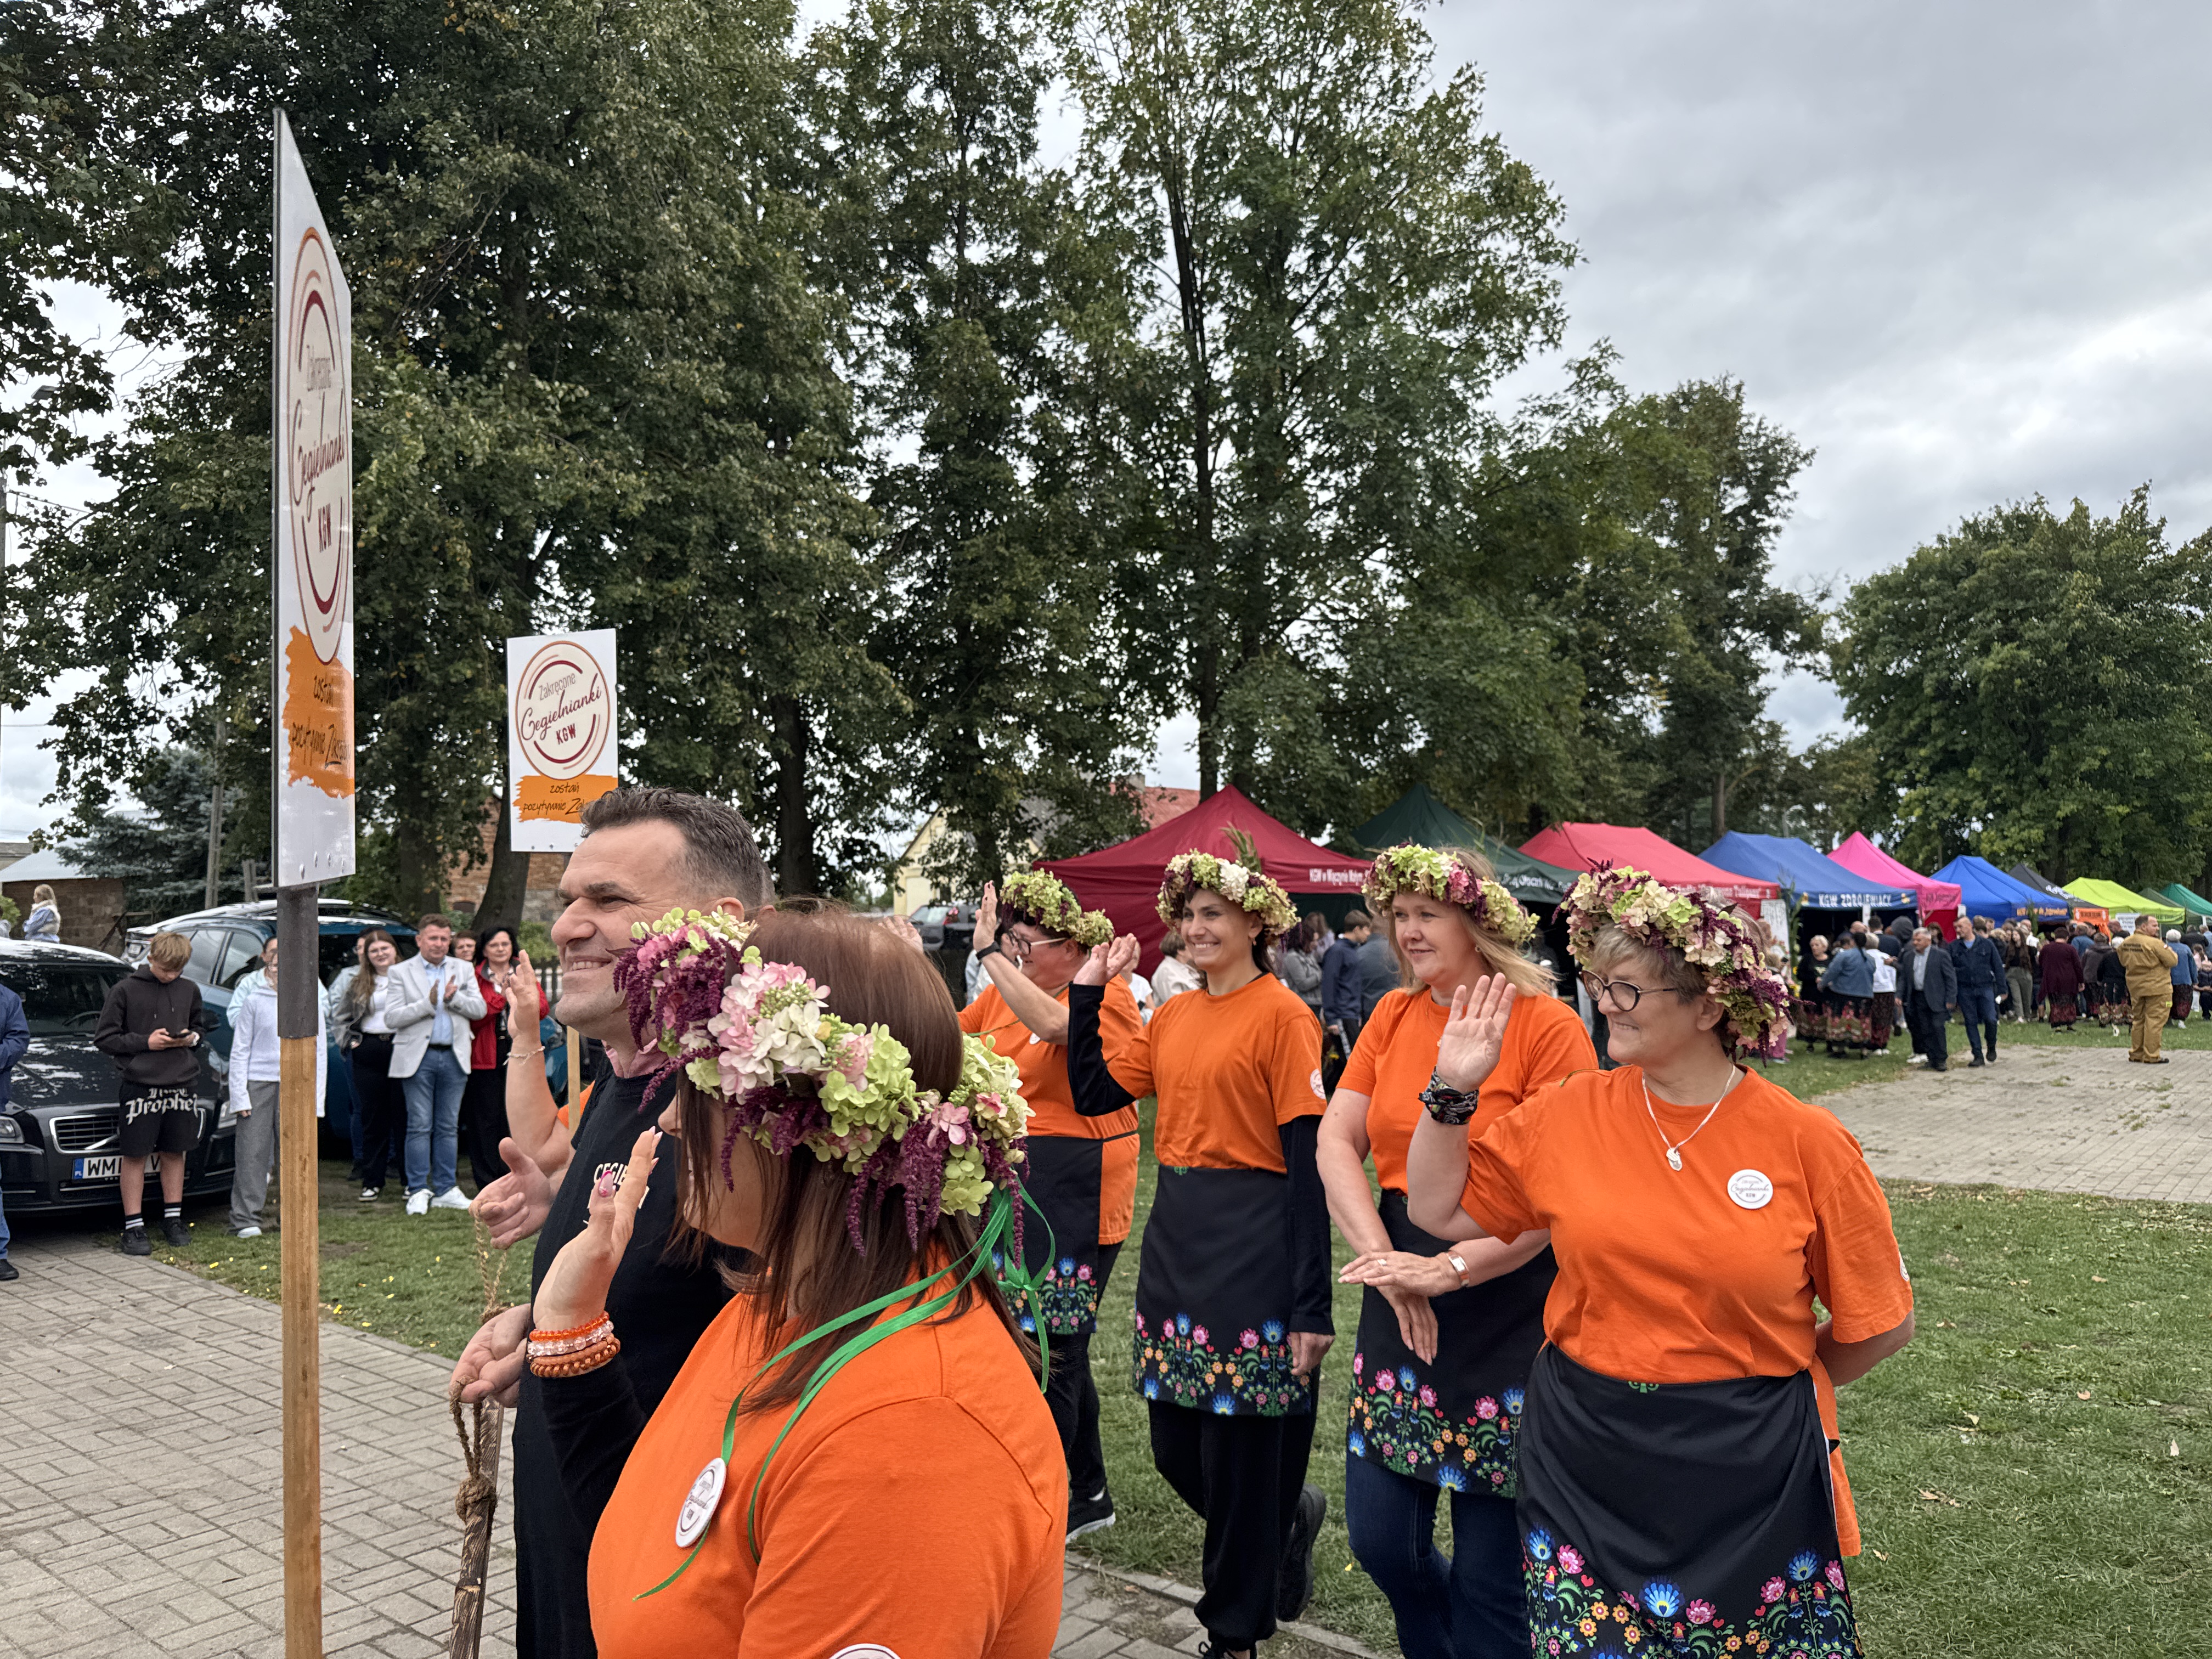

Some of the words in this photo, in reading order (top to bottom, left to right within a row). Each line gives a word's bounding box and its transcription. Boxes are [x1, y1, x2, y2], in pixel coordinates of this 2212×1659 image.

[538, 673, 577, 701] Zakręcone
[521, 673, 602, 741] Cegielnianki
[556, 723, 577, 745] KGW
[550, 781, 580, 793] zostań
[523, 800, 567, 815] pozytywnie
[1819, 894, 1838, 907] KGW
